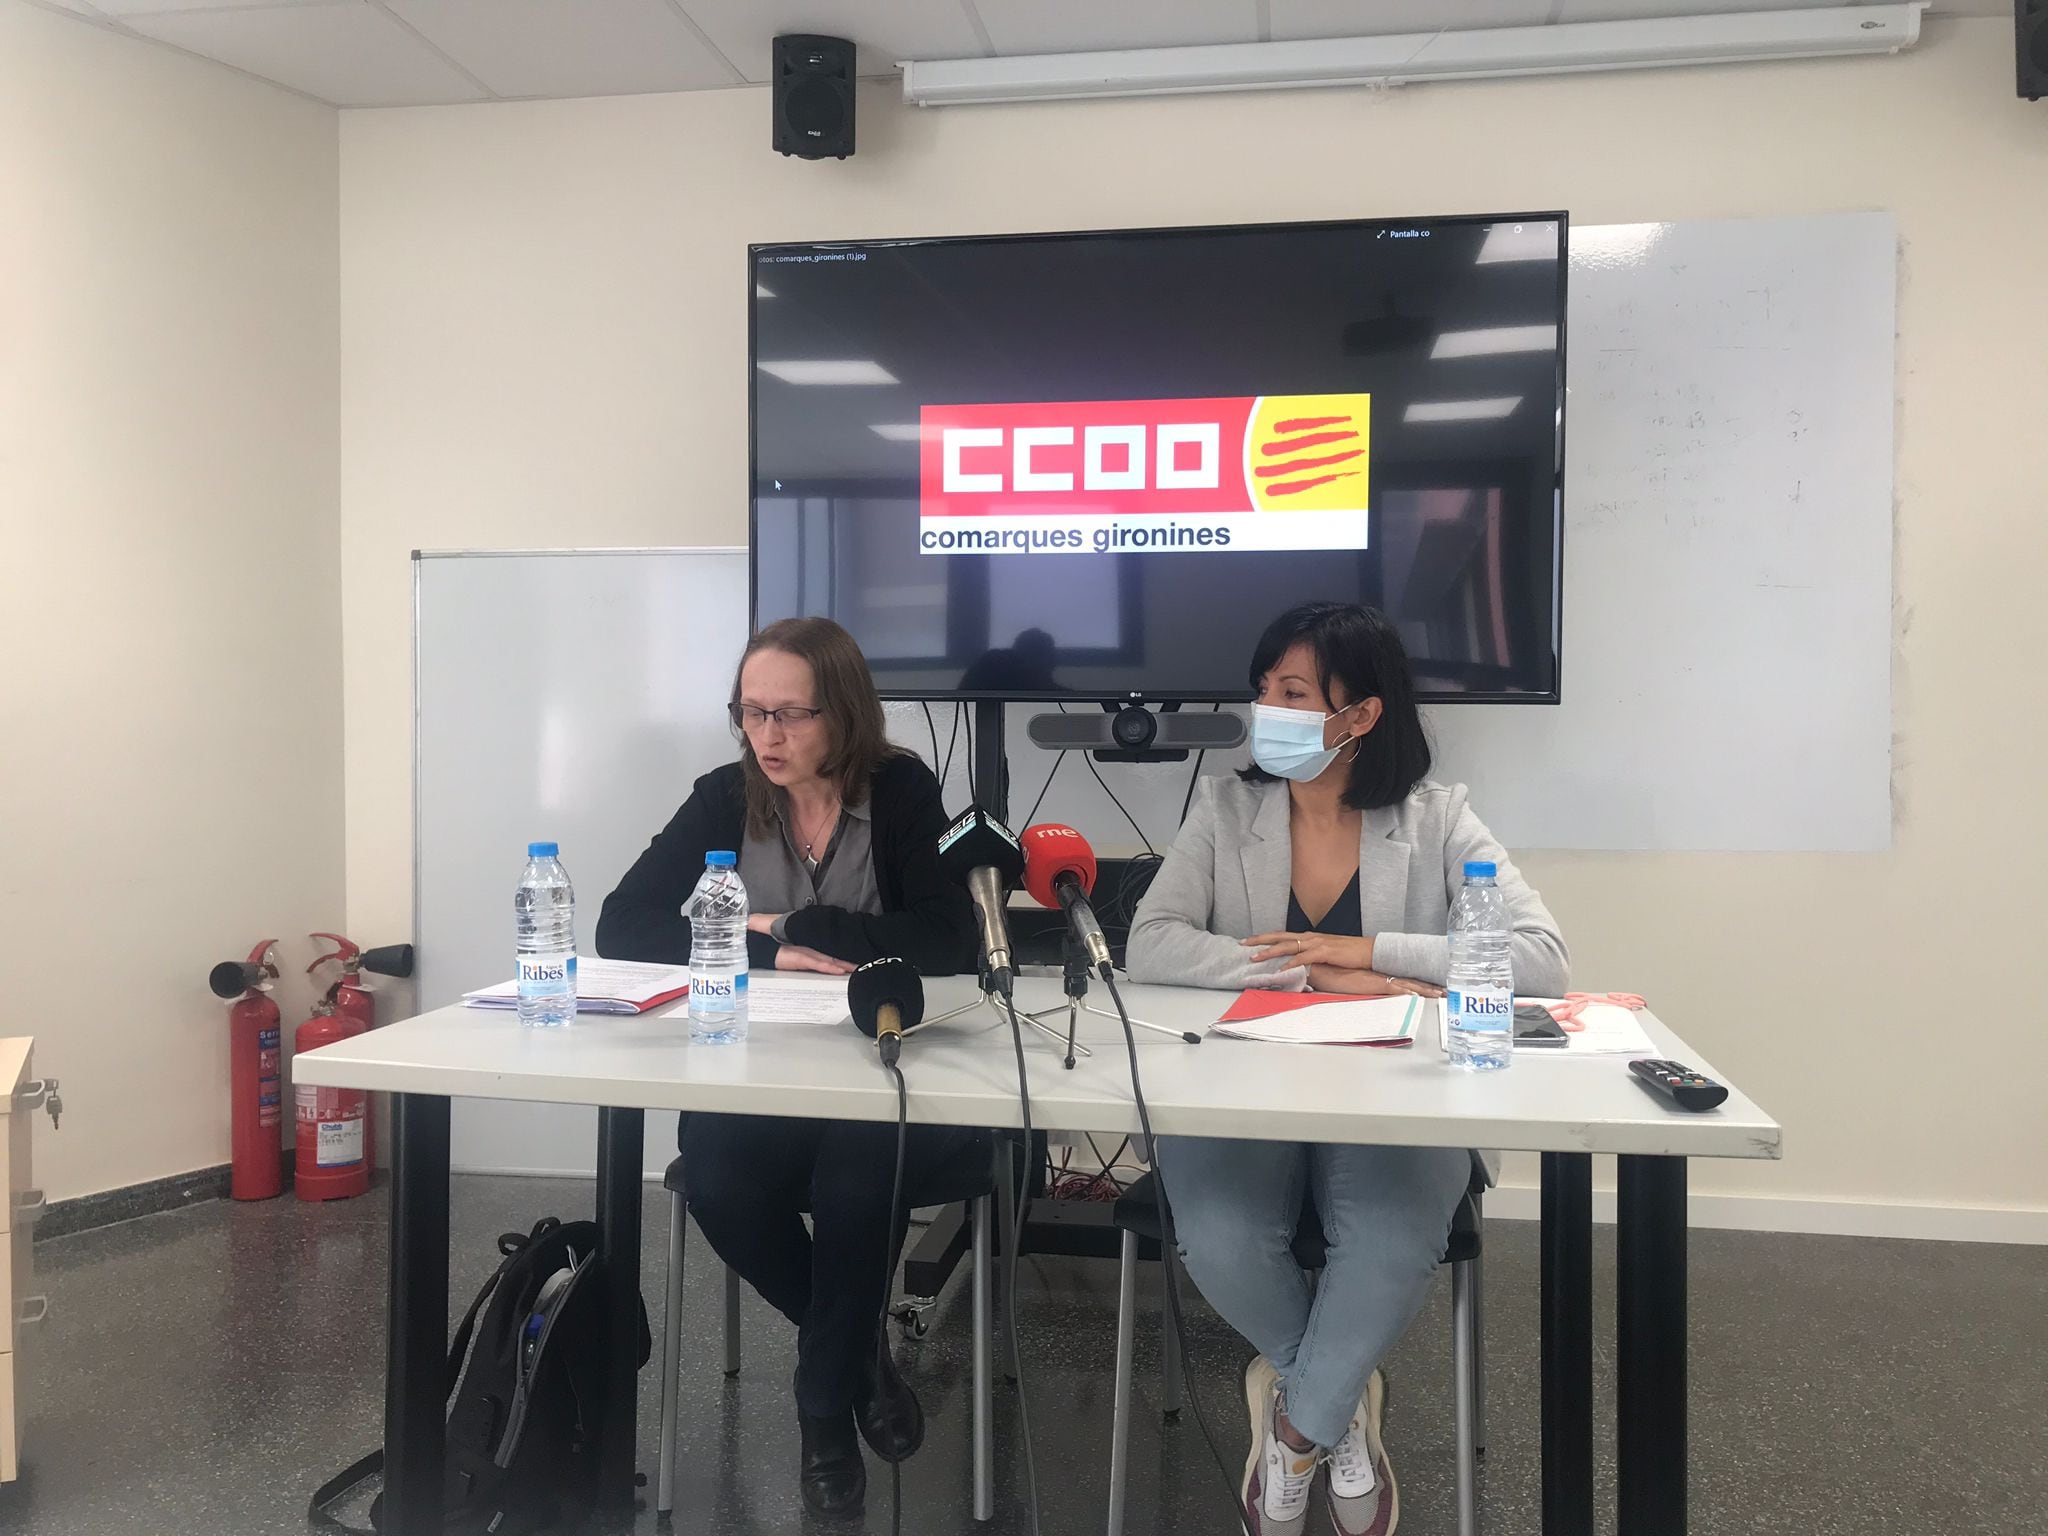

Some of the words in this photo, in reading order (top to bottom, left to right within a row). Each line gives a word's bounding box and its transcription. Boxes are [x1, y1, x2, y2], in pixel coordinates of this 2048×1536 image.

[1390, 230, 1419, 238] Pantalla
[775, 253, 845, 264] comarques_gironines
[943, 423, 1220, 492] CCOO
[921, 529, 1083, 554] comarques
[1092, 522, 1231, 553] gironines
[937, 811, 976, 848] SER
[1036, 828, 1079, 839] rne
[523, 965, 564, 981] Ribes
[858, 957, 903, 972] acn
[692, 978, 731, 996] Ribes
[1464, 996, 1509, 1014] Ribes
